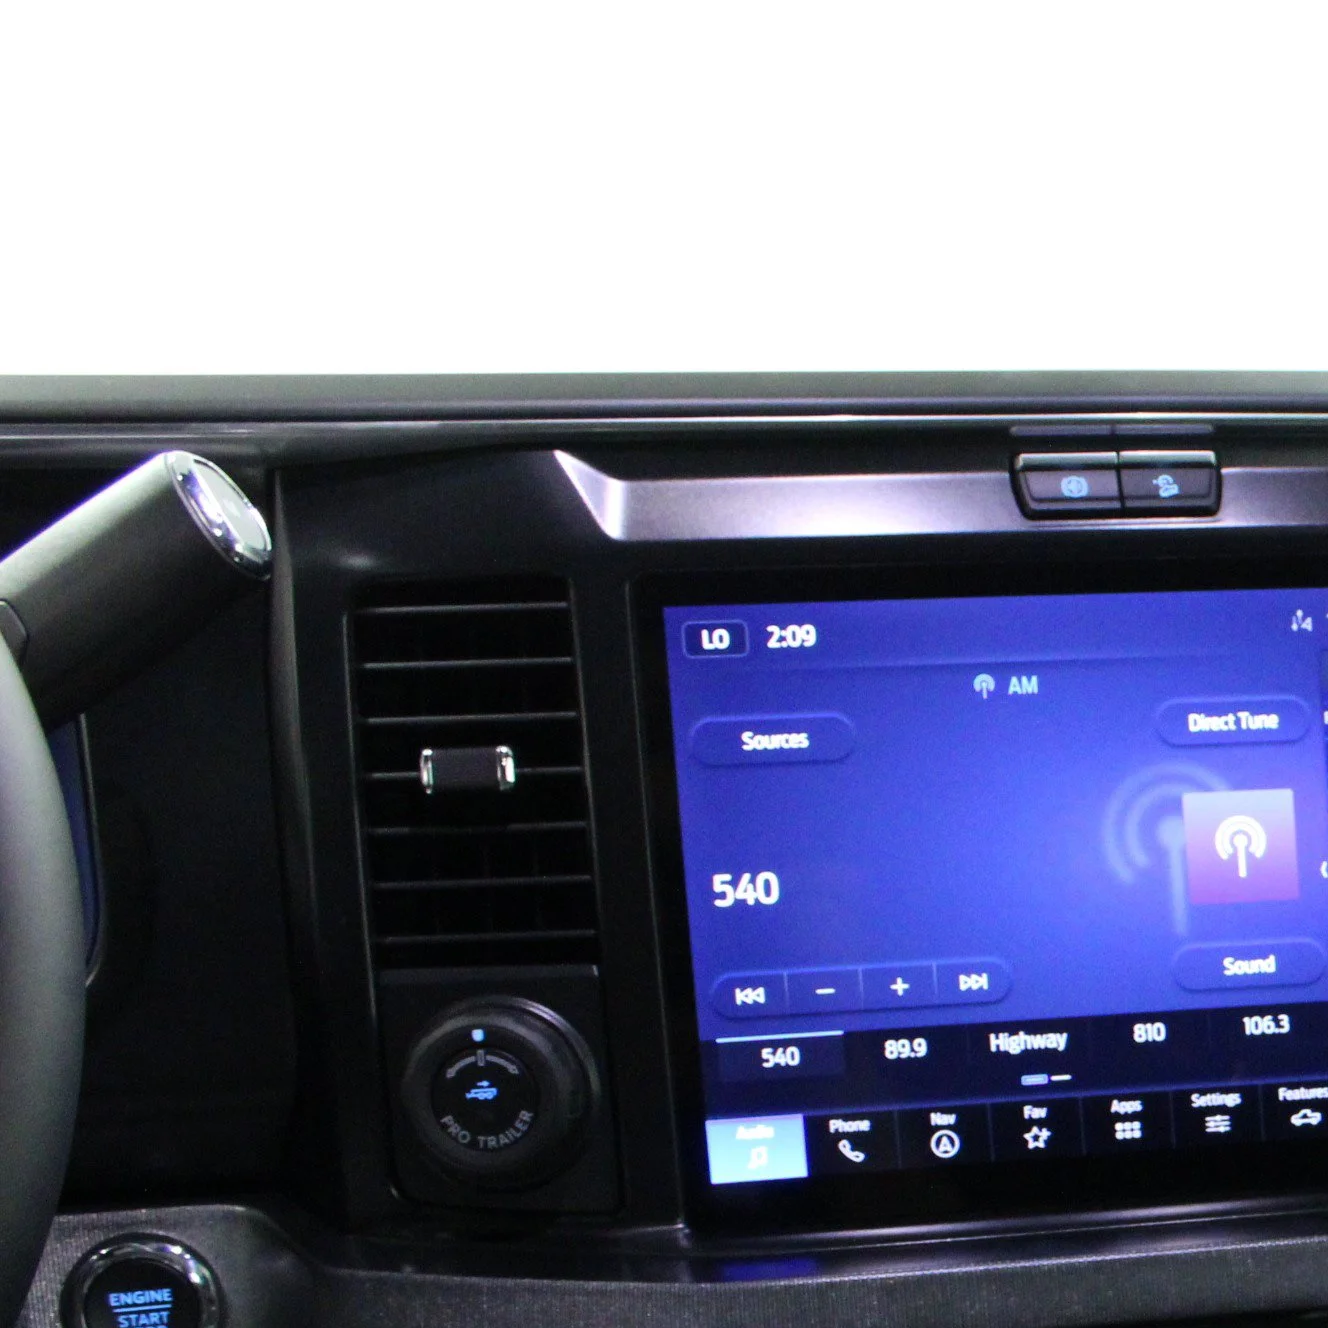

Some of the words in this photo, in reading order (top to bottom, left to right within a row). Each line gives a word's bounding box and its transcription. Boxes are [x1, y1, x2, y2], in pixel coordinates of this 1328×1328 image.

[701, 628, 731, 650] LO
[766, 624, 818, 649] 2:09
[1008, 675, 1039, 695] AM
[1188, 712, 1235, 732] Direct
[1237, 710, 1279, 730] Tune
[741, 731, 810, 752] Sources
[712, 871, 780, 908] 540
[1223, 955, 1276, 976] Sound
[1133, 1022, 1166, 1044] 810
[1242, 1014, 1290, 1037] 106.3
[884, 1037, 928, 1060] 89.9
[988, 1031, 1068, 1055] Highway
[761, 1046, 801, 1069] 540
[1110, 1099, 1143, 1116] Apps
[1191, 1091, 1242, 1109] Settings
[930, 1112, 957, 1127] Nav
[1023, 1104, 1048, 1120] Fav
[440, 1115, 471, 1144] PRO
[477, 1110, 534, 1149] TRAILER
[829, 1117, 871, 1134] Phone
[108, 1288, 173, 1306] ENGINE
[117, 1311, 171, 1328] START
